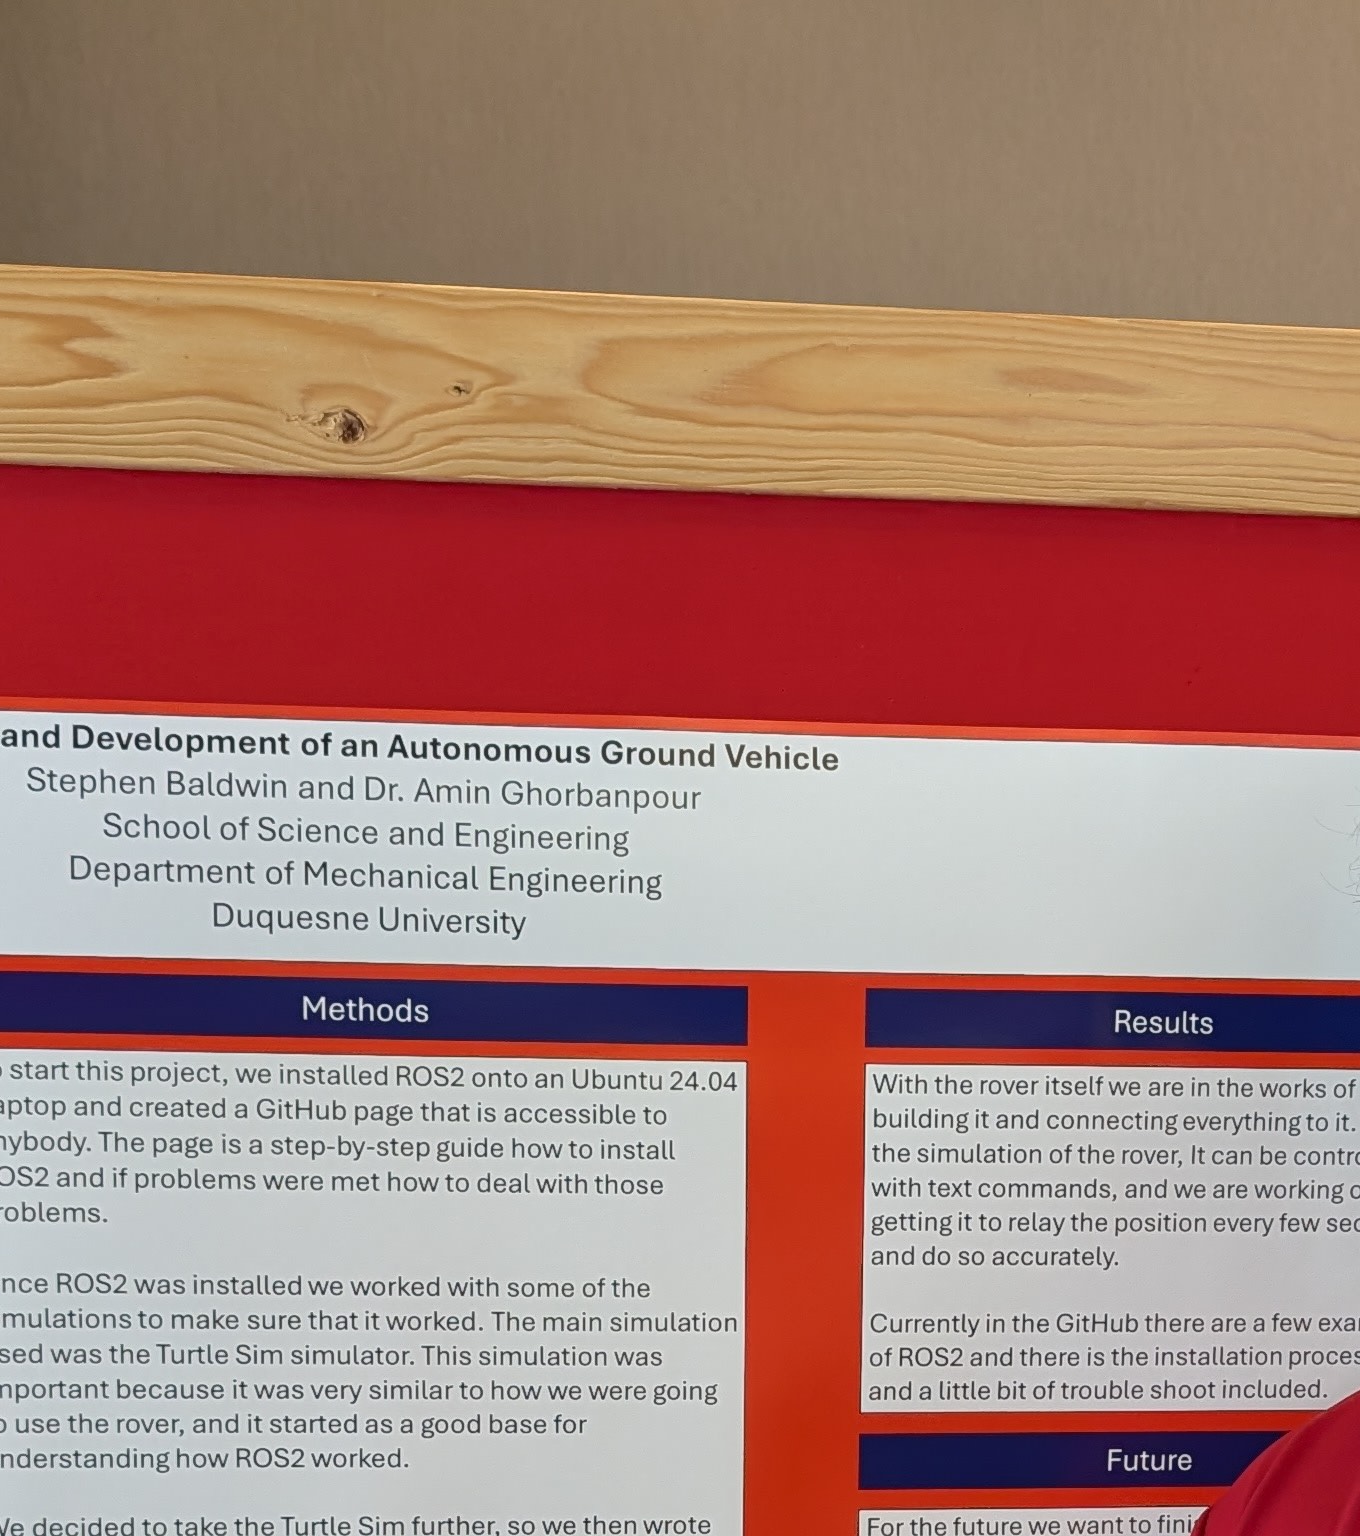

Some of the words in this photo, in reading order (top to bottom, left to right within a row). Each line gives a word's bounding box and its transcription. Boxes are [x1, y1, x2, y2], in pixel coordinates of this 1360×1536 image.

[0, 723, 61, 749] and
[72, 724, 291, 759] Development
[300, 731, 333, 757] of
[340, 738, 379, 758] an
[386, 733, 591, 765] Autonomous
[600, 739, 715, 768] Ground
[724, 743, 839, 772] Vehicle
[26, 766, 156, 800] Stephen
[167, 770, 287, 799] Baldwin
[298, 775, 354, 801] and
[364, 775, 404, 802] Dr.
[413, 777, 490, 805] Amin
[501, 780, 702, 815] Ghorbanpour
[103, 812, 212, 841] School
[219, 815, 250, 841] of
[257, 816, 379, 845] Science
[388, 821, 444, 847] and
[455, 821, 630, 858] Engineering
[70, 854, 256, 888] Department
[265, 860, 295, 886] of
[304, 860, 479, 891] Mechanical
[489, 865, 663, 901] Engineering
[213, 902, 369, 935] Duquesne
[379, 906, 527, 941] University
[303, 996, 428, 1022] Methods
[1115, 1010, 1213, 1034] Results
[9, 1060, 70, 1081] start
[74, 1059, 124, 1082] this
[130, 1061, 228, 1088] project,
[234, 1067, 272, 1085] we
[279, 1063, 389, 1087] installed
[396, 1065, 465, 1088] ROS2
[471, 1069, 528, 1089] onto
[534, 1072, 564, 1089] an
[572, 1068, 663, 1091] Ubuntu
[669, 1070, 738, 1092] 24.04
[870, 1211, 953, 1237] getting
[958, 1211, 973, 1232] it
[978, 1213, 1002, 1232] to
[1008, 1211, 1066, 1237] relay
[1069, 1211, 1108, 1233] the
[1114, 1212, 1207, 1237] position
[1213, 1217, 1275, 1238] every
[1278, 1212, 1321, 1233] few
[870, 1245, 915, 1266] and
[921, 1245, 951, 1266] do
[957, 1250, 985, 1266] so
[991, 1245, 1119, 1271] accurately.
[176, 1447, 230, 1469] how
[235, 1447, 306, 1469] ROS2
[310, 1447, 409, 1469] worked.
[1108, 1449, 1191, 1471] Future
